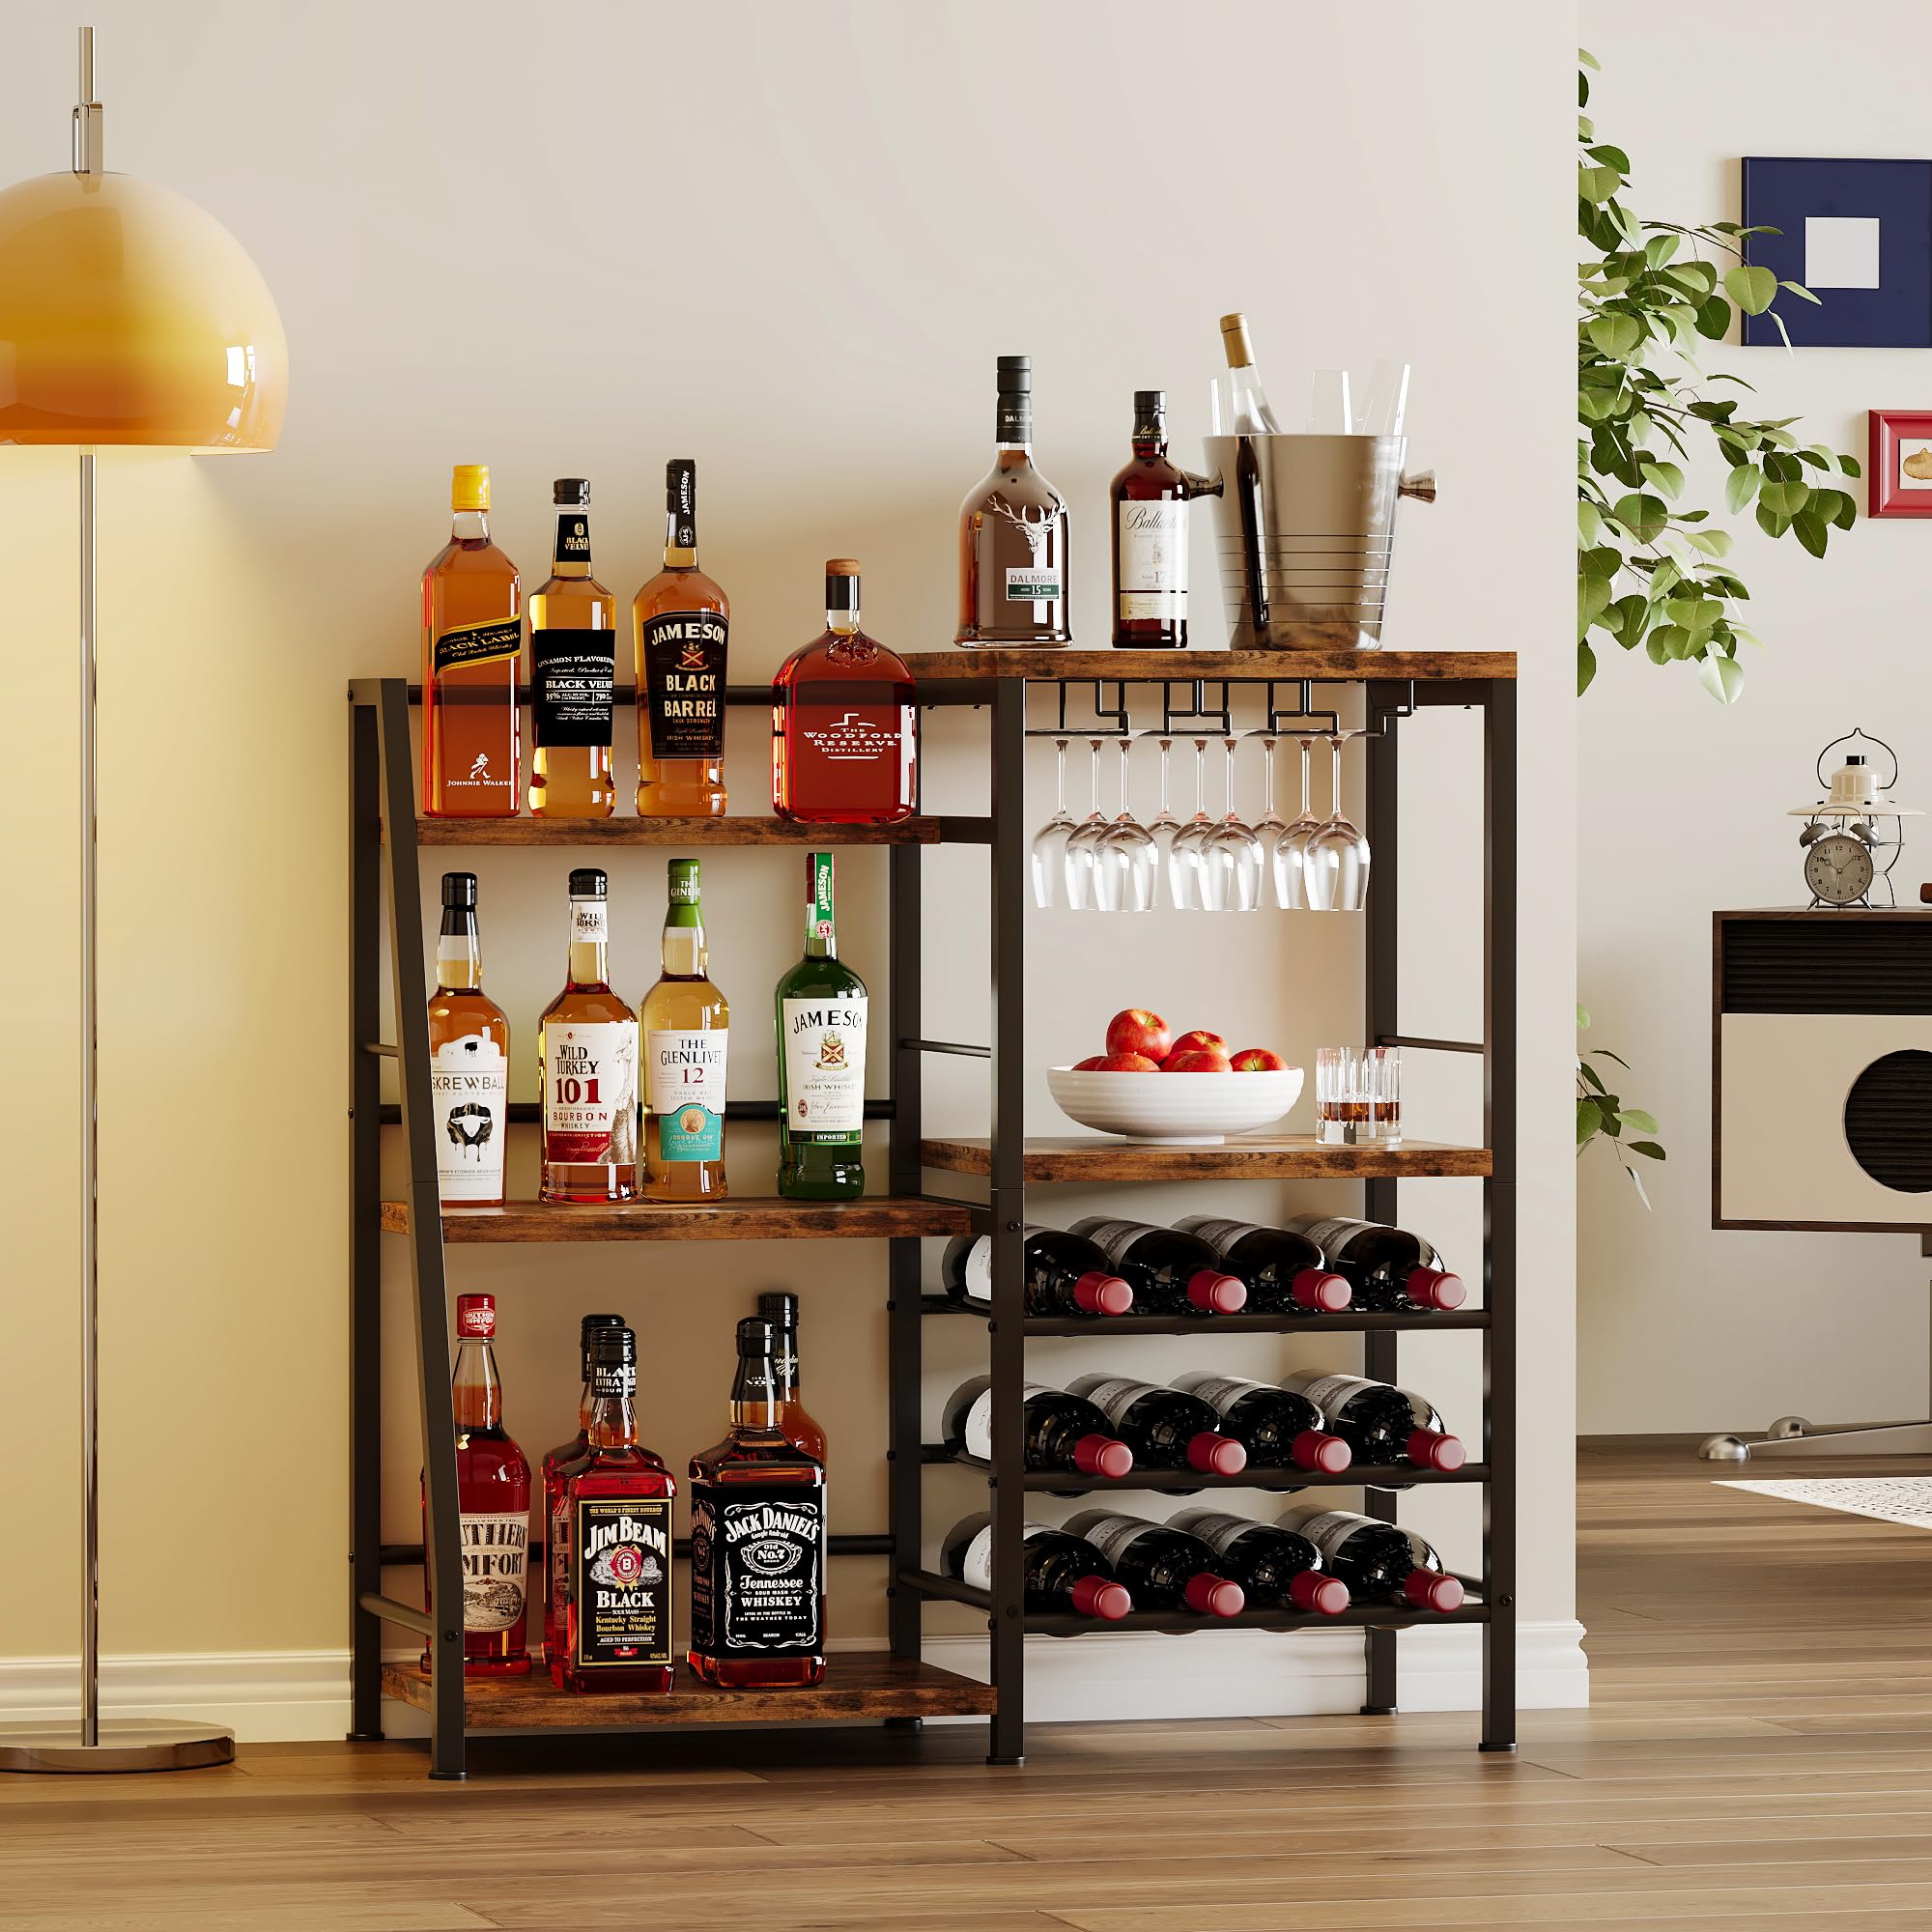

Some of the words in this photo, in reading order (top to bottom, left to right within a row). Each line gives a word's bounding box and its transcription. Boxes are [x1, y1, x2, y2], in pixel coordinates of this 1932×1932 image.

[680, 470, 691, 515] JAMESON
[1010, 575, 1058, 583] DALMORE
[1032, 584, 1041, 595] 15
[480, 632, 520, 645] LABEL
[651, 623, 725, 646] JAMESON
[546, 680, 586, 690] BLACK
[667, 674, 716, 692] BLACK
[546, 692, 561, 701] 35%
[665, 699, 717, 717] BARREL
[817, 865, 830, 911] JAMESON
[679, 1038, 707, 1049] THE
[559, 1044, 588, 1061] WILD
[661, 1050, 722, 1065] GLENLIVET
[555, 1057, 600, 1076] TURKEY
[681, 1067, 704, 1084] 12
[555, 1078, 602, 1104] 101
[553, 1112, 608, 1122] BOURBON
[724, 1513, 763, 1543] JACK
[762, 1507, 821, 1541] DANIEL'S
[583, 1524, 619, 1560] JIM
[618, 1516, 668, 1559] BEAM
[757, 1549, 785, 1560] No.7
[622, 1558, 632, 1571] B
[739, 1575, 804, 1590] Tennessee
[596, 1590, 655, 1608] BLACK
[741, 1596, 803, 1607] WHISKEY
[595, 1615, 627, 1625] Kentucky
[629, 1614, 656, 1624] Straight
[596, 1624, 625, 1633] Bourbon
[627, 1623, 656, 1633] Whiskey
